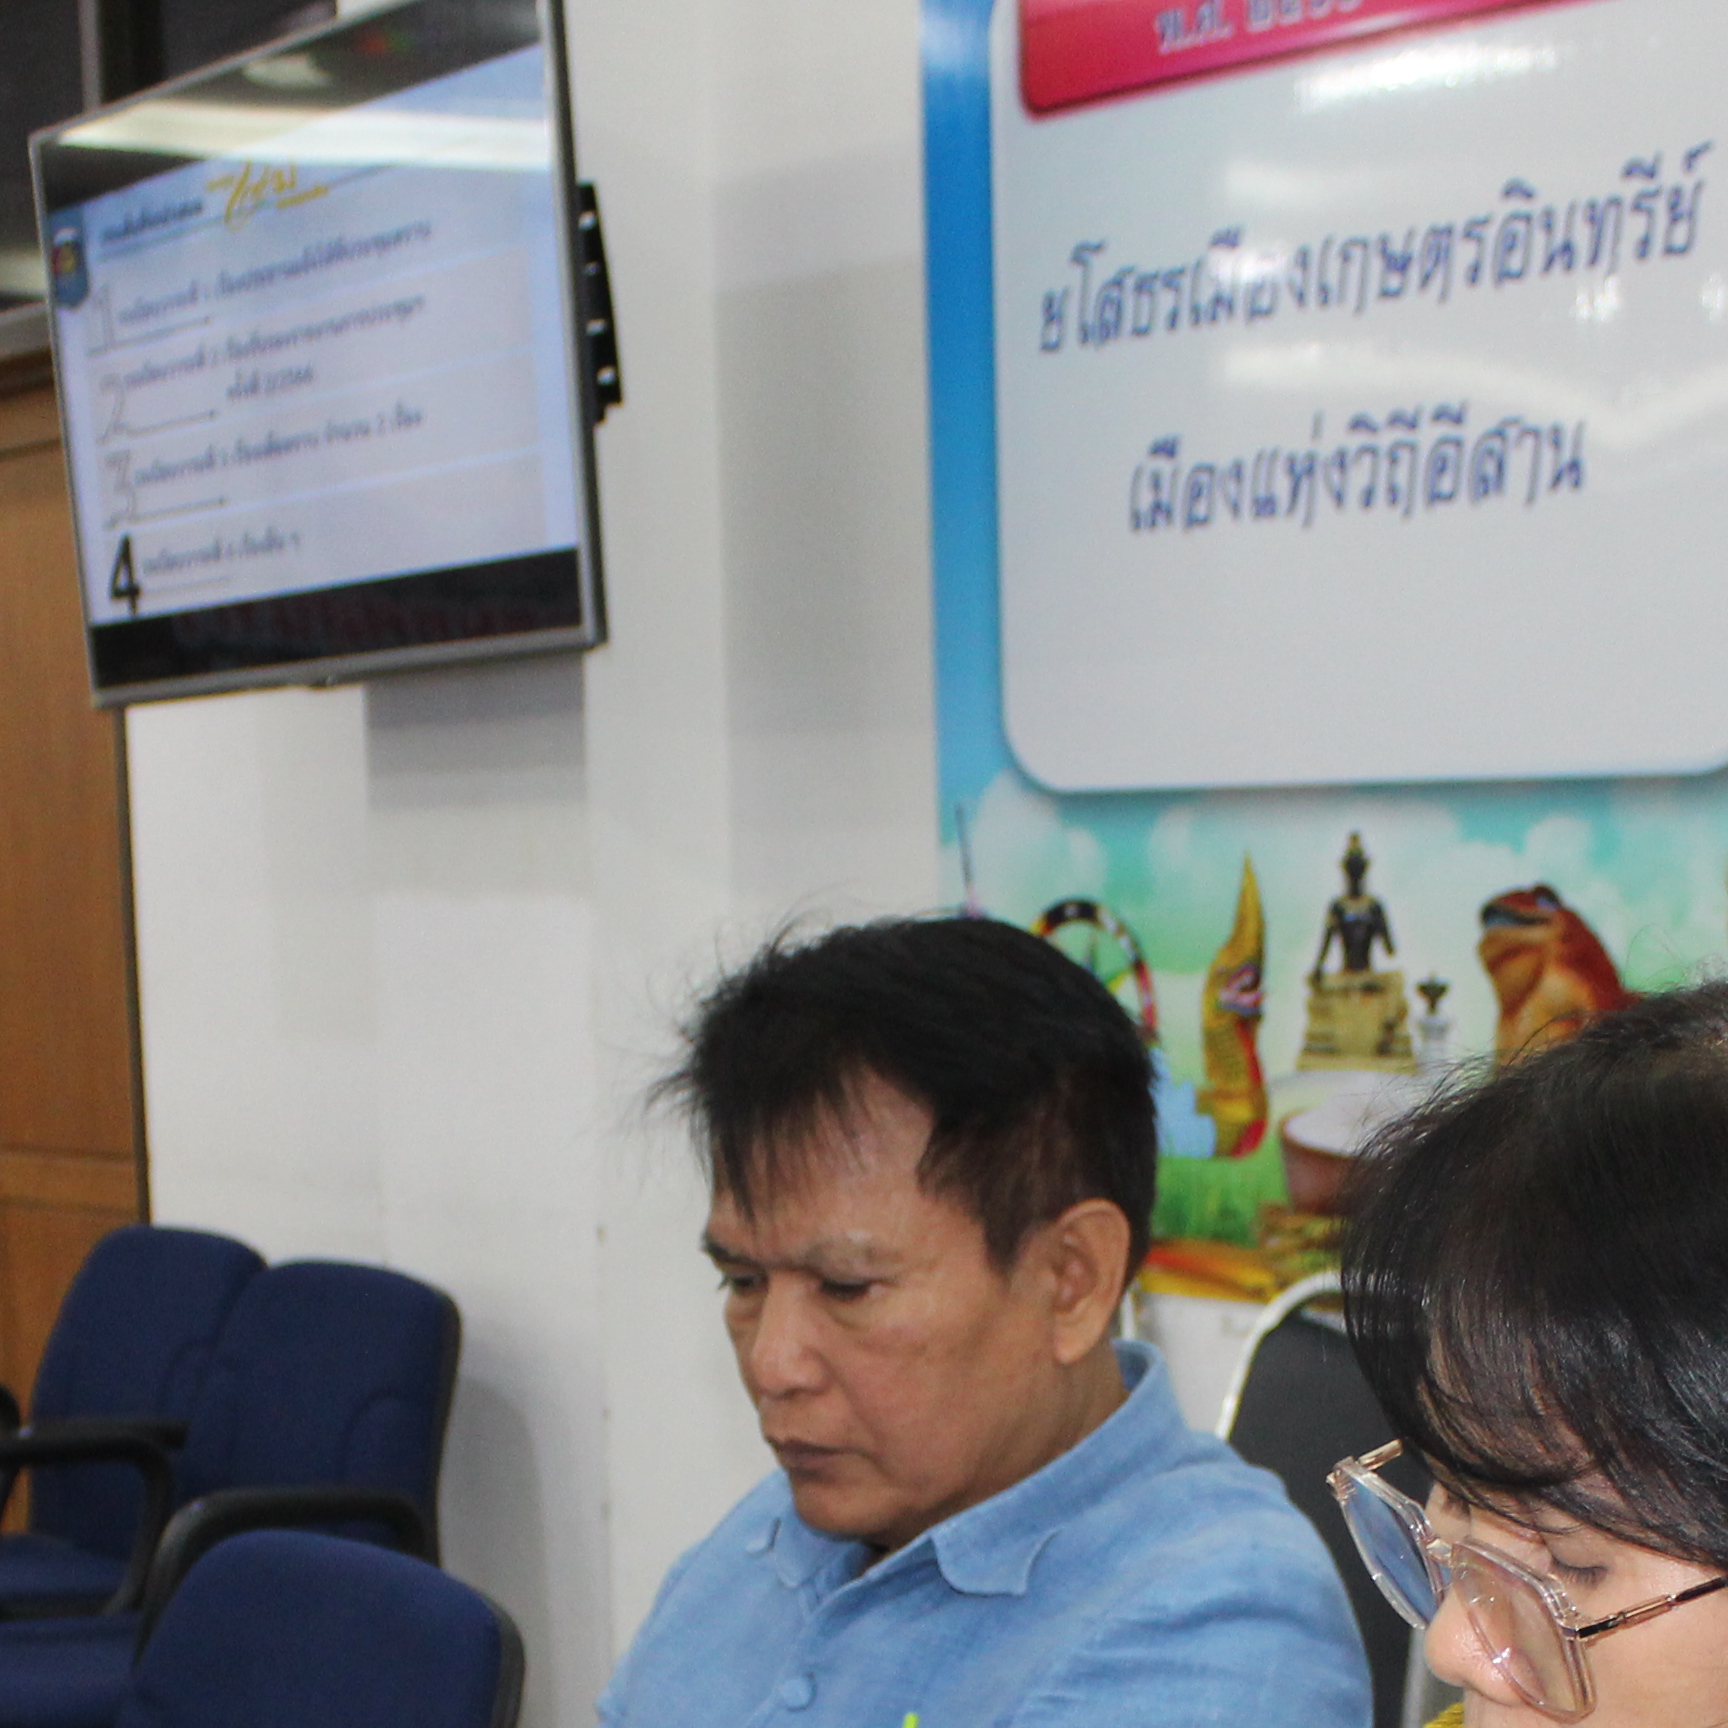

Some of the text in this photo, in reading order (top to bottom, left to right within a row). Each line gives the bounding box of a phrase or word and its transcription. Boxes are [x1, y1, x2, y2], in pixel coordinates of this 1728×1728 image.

[1039, 140, 1714, 353] ยโสธรเมืองเกษตรอินทรีย์
[1128, 400, 1588, 533] เมืองแห่งวิถีอีสาน
[109, 532, 143, 616] 4
